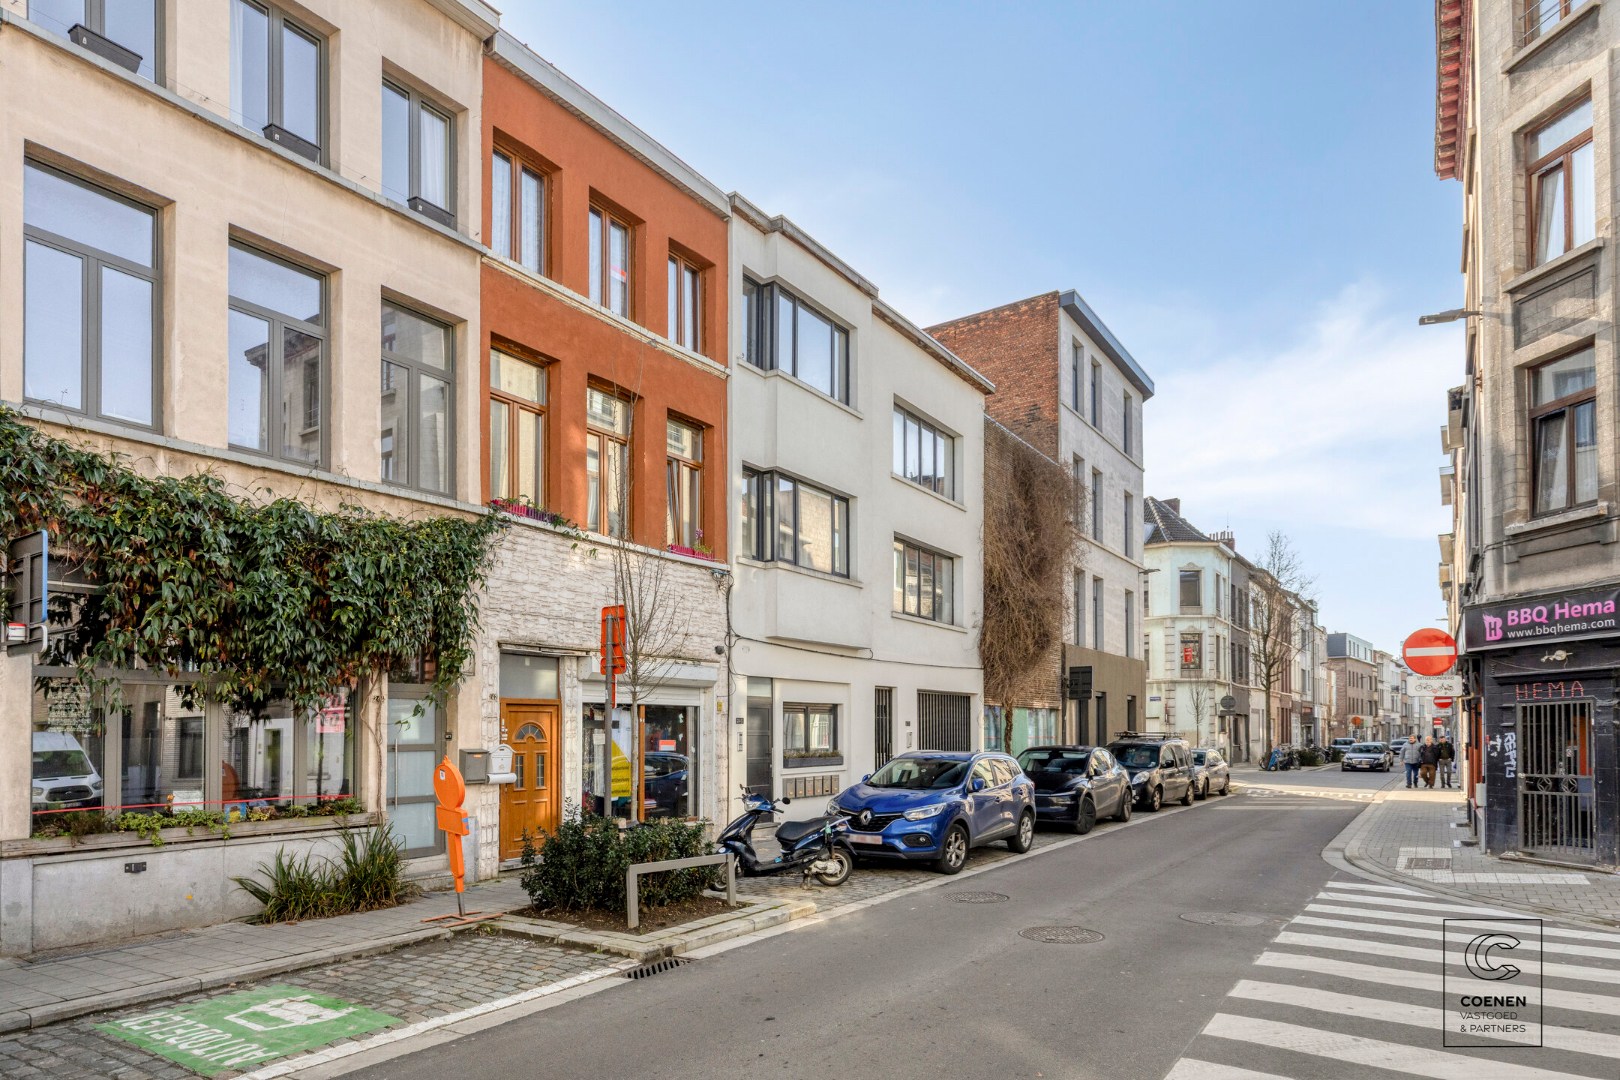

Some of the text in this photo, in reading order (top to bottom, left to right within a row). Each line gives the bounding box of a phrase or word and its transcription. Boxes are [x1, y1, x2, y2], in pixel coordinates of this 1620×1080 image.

[1507, 600, 1615, 626] BBQ Hema
[1507, 619, 1615, 638] www.bbqhema.com
[1515, 680, 1585, 701] HEMA
